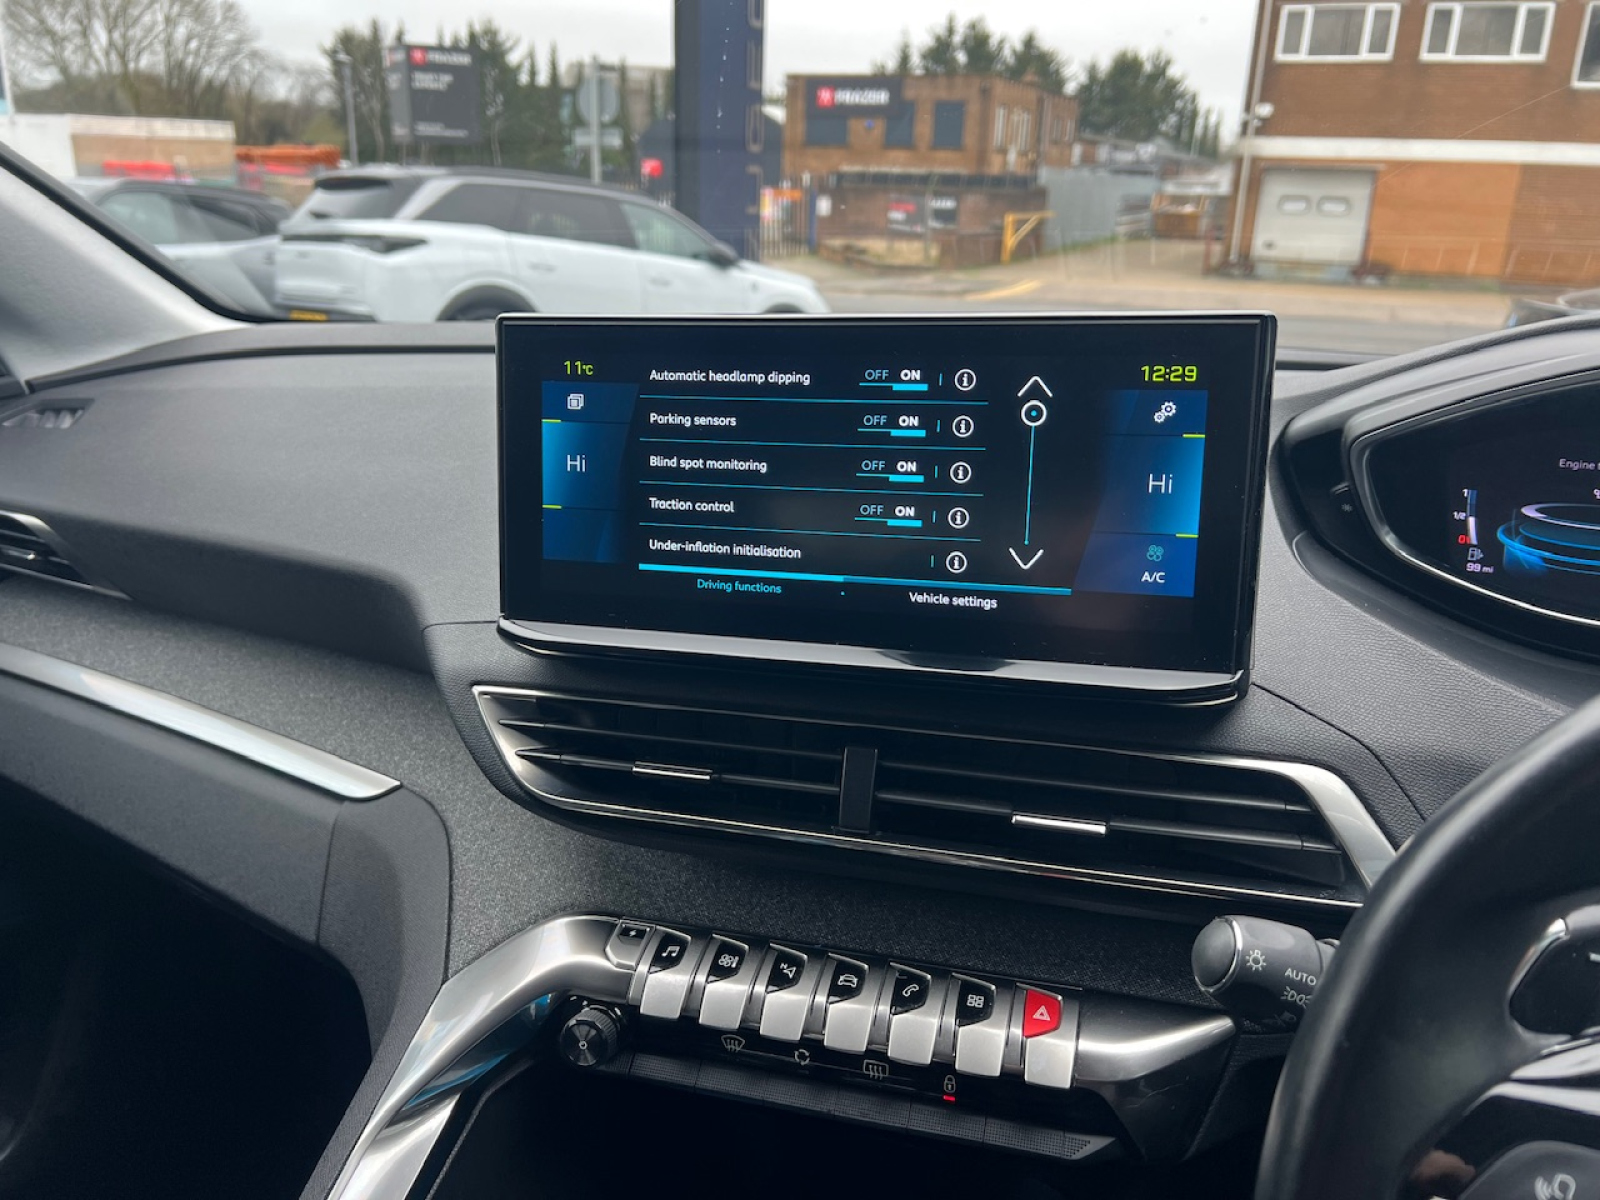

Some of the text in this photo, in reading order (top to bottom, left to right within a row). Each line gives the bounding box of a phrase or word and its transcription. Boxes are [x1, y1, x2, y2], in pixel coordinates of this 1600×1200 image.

[649, 369, 811, 385] Automatic headlamp dipping
[864, 369, 921, 381] OFF ON
[1140, 365, 1198, 382] 12:29
[649, 413, 737, 427] Parking sensors
[863, 415, 919, 427] OFF ON
[566, 454, 586, 472] Hi
[649, 455, 767, 474] Blind spot monitoring
[861, 460, 917, 472] OFF ON
[1559, 458, 1596, 471] Engine
[1148, 473, 1174, 494] Hi
[649, 497, 735, 513] Traction control
[860, 504, 915, 517] OFF ON
[649, 539, 801, 558] Under-inflation initialisation
[1140, 571, 1166, 584] A/C
[697, 578, 782, 594] Driving functions
[909, 591, 998, 610] Vehicle settings
[1284, 967, 1317, 986] AUTO
